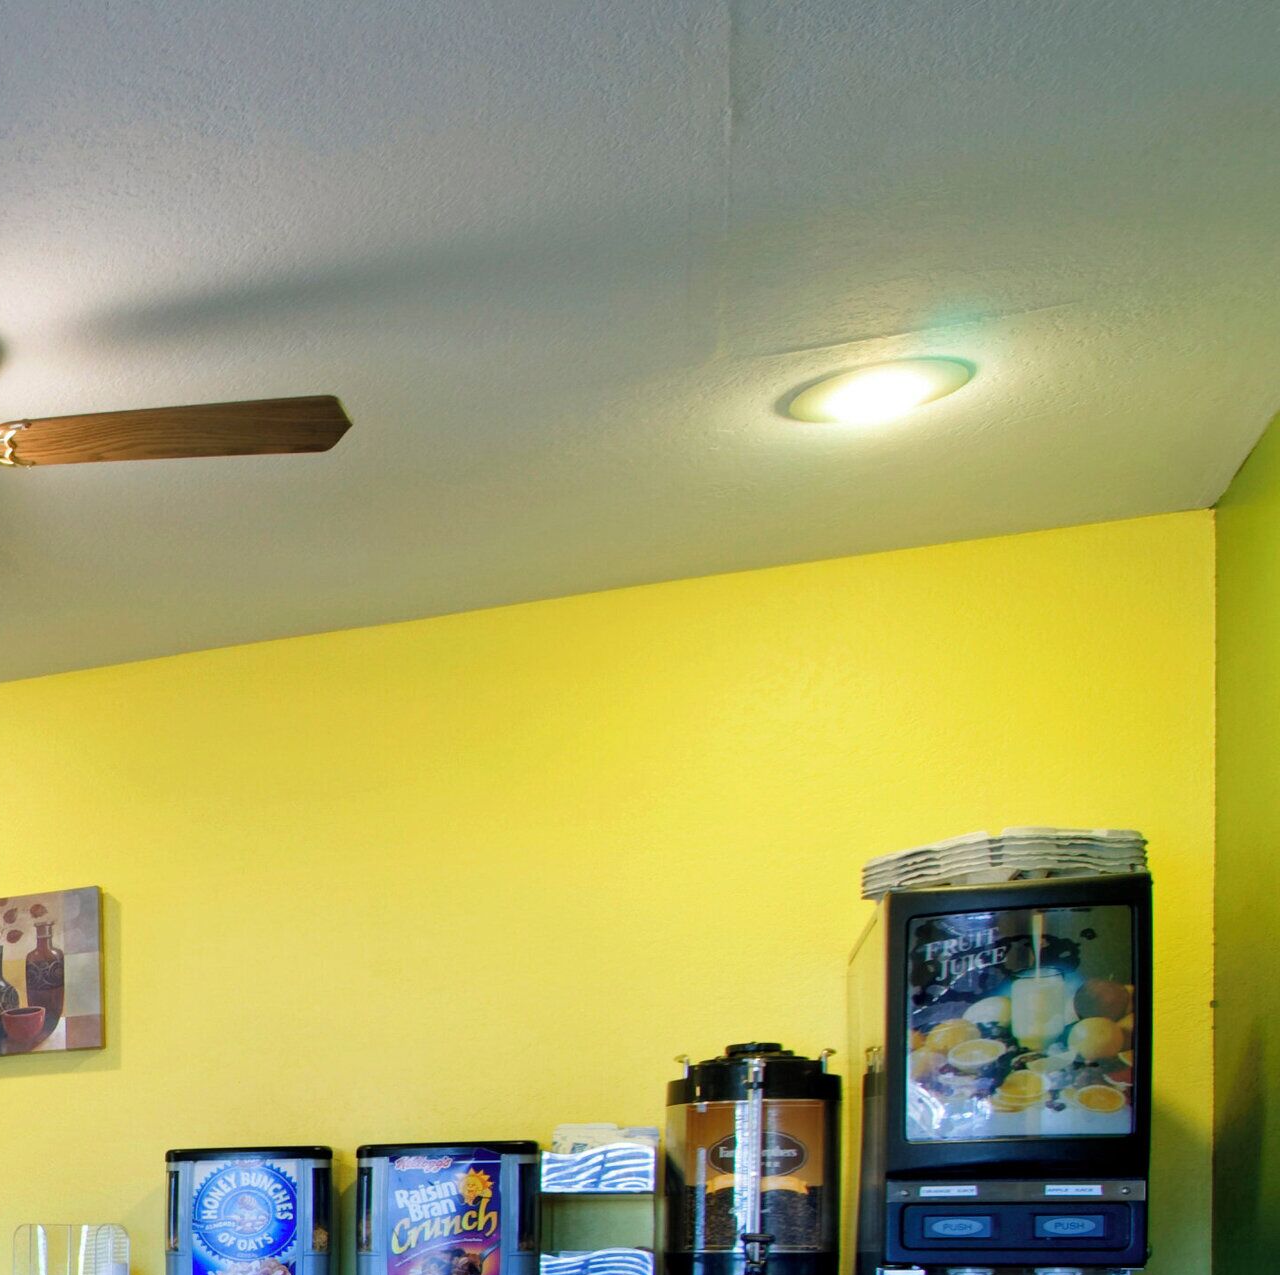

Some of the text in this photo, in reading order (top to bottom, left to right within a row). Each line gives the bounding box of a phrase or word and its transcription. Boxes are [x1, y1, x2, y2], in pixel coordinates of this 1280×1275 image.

[924, 927, 999, 962] FRUIT
[936, 946, 1008, 982] JUICE
[395, 1156, 453, 1173] Kellogg's
[202, 1172, 294, 1220] HONEY BUNCHES
[395, 1180, 458, 1209] Raisin
[392, 1192, 497, 1254] Crunch
[409, 1198, 457, 1222] Bran
[1054, 1222, 1085, 1230] PUSH
[218, 1232, 274, 1251] OF OATS
